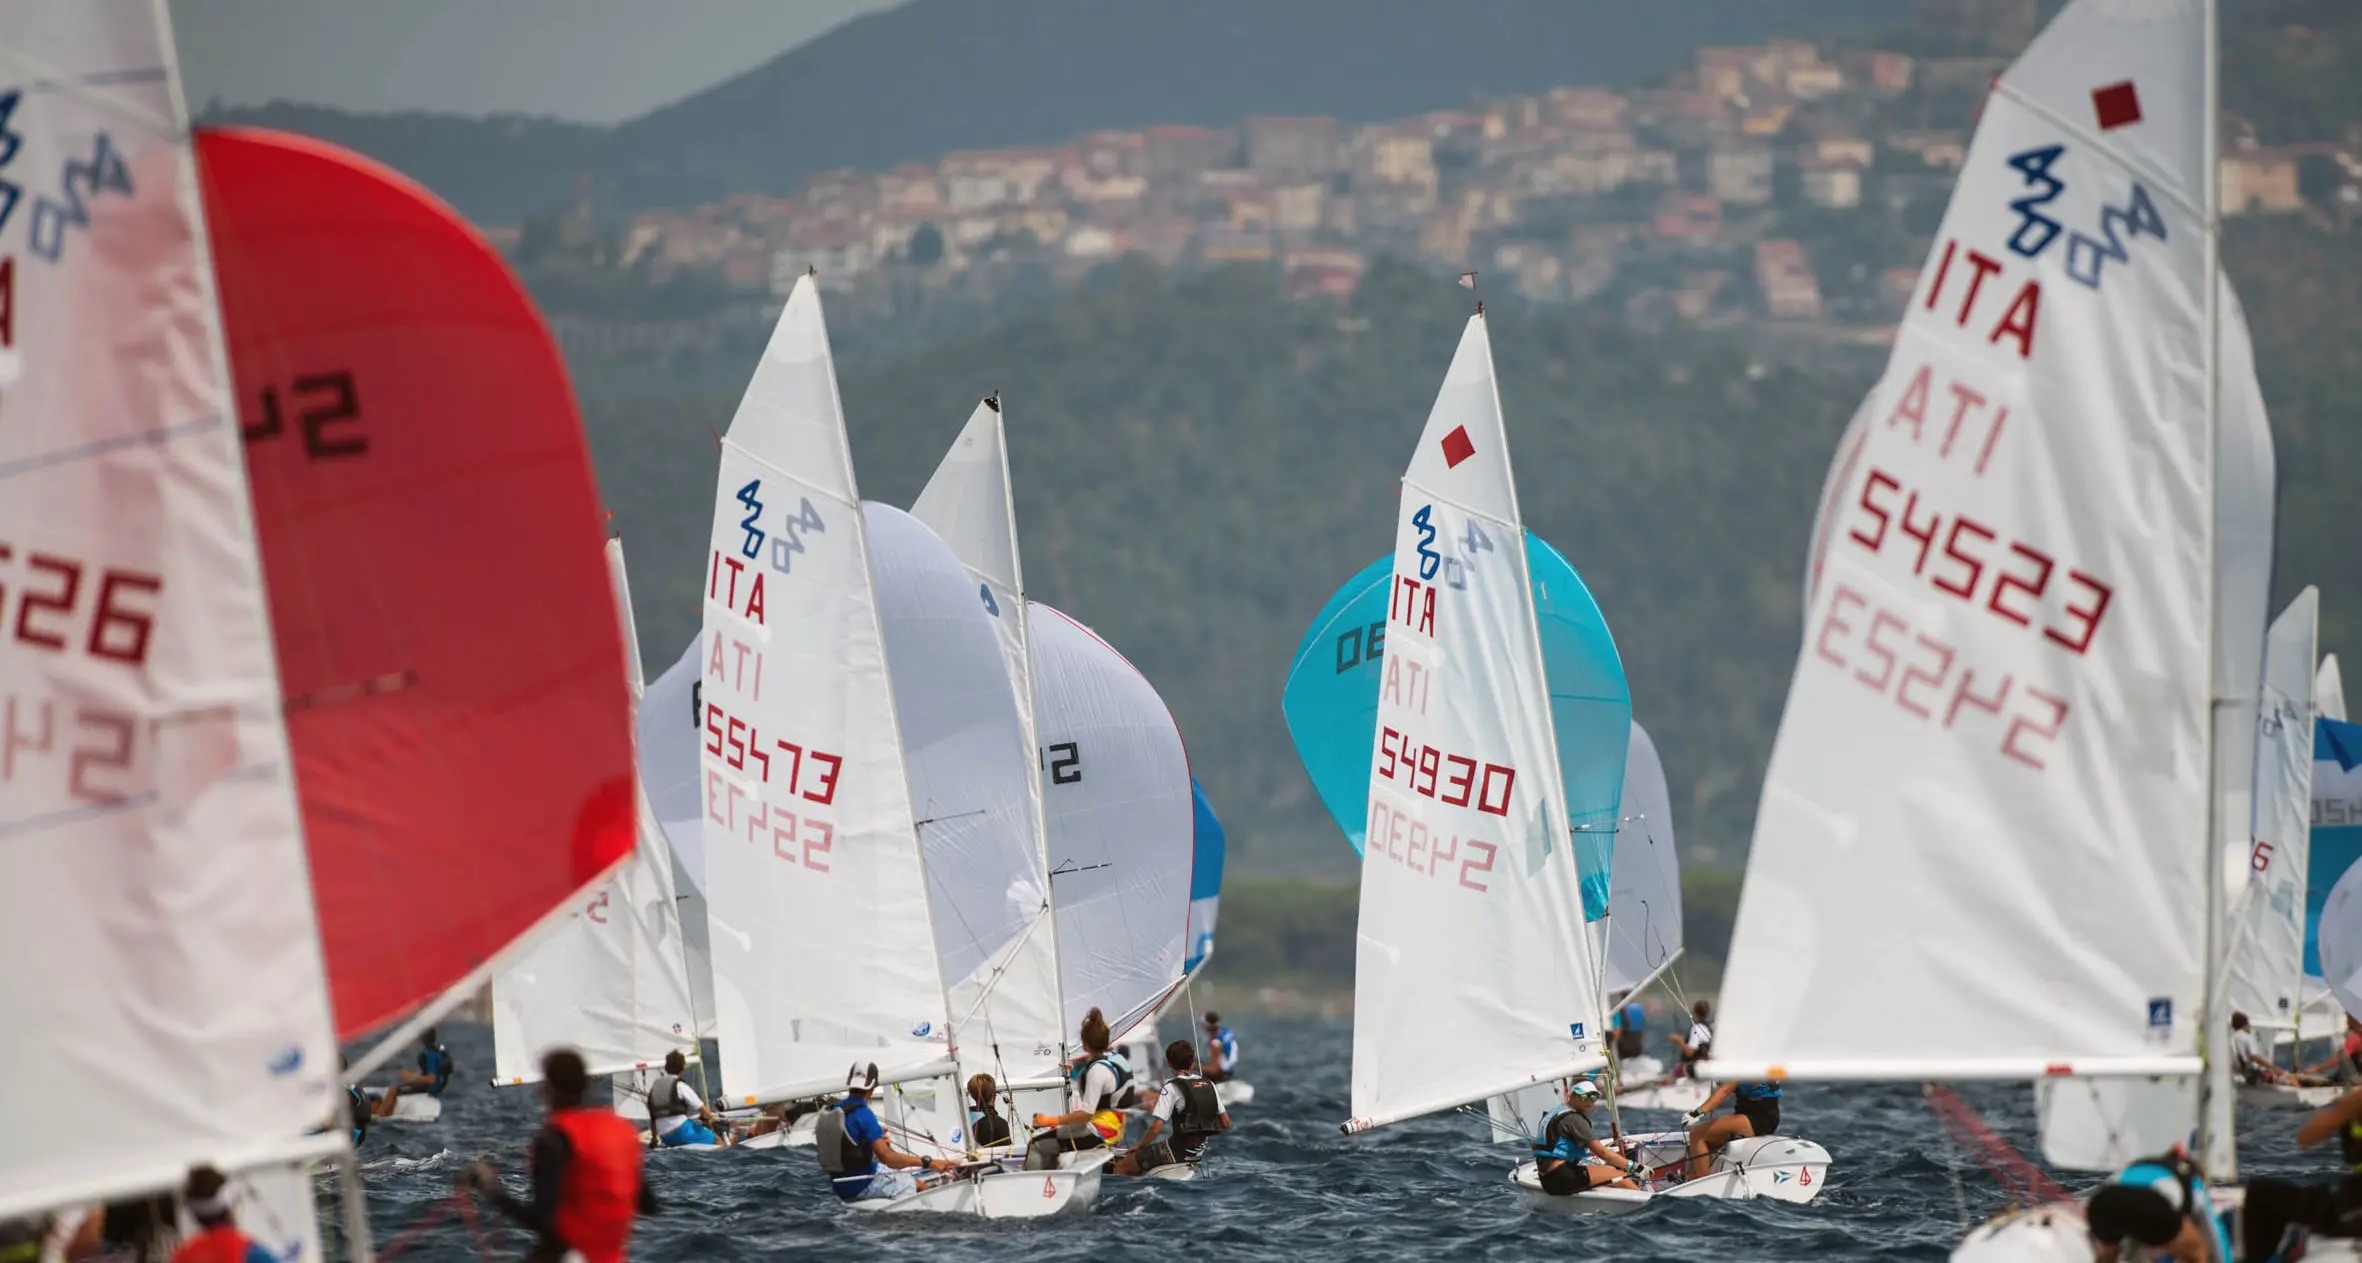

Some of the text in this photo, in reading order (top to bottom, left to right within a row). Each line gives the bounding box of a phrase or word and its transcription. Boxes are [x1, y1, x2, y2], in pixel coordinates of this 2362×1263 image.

[2007, 144, 2066, 259] 420
[1925, 240, 2041, 360] ITA
[735, 478, 766, 560] 420
[1412, 504, 1442, 581] 420
[1849, 468, 2113, 656] 54523
[710, 550, 766, 625] ITA
[1391, 574, 1436, 638] ITA
[706, 702, 844, 806] 55473
[1378, 725, 1516, 817] 54930
